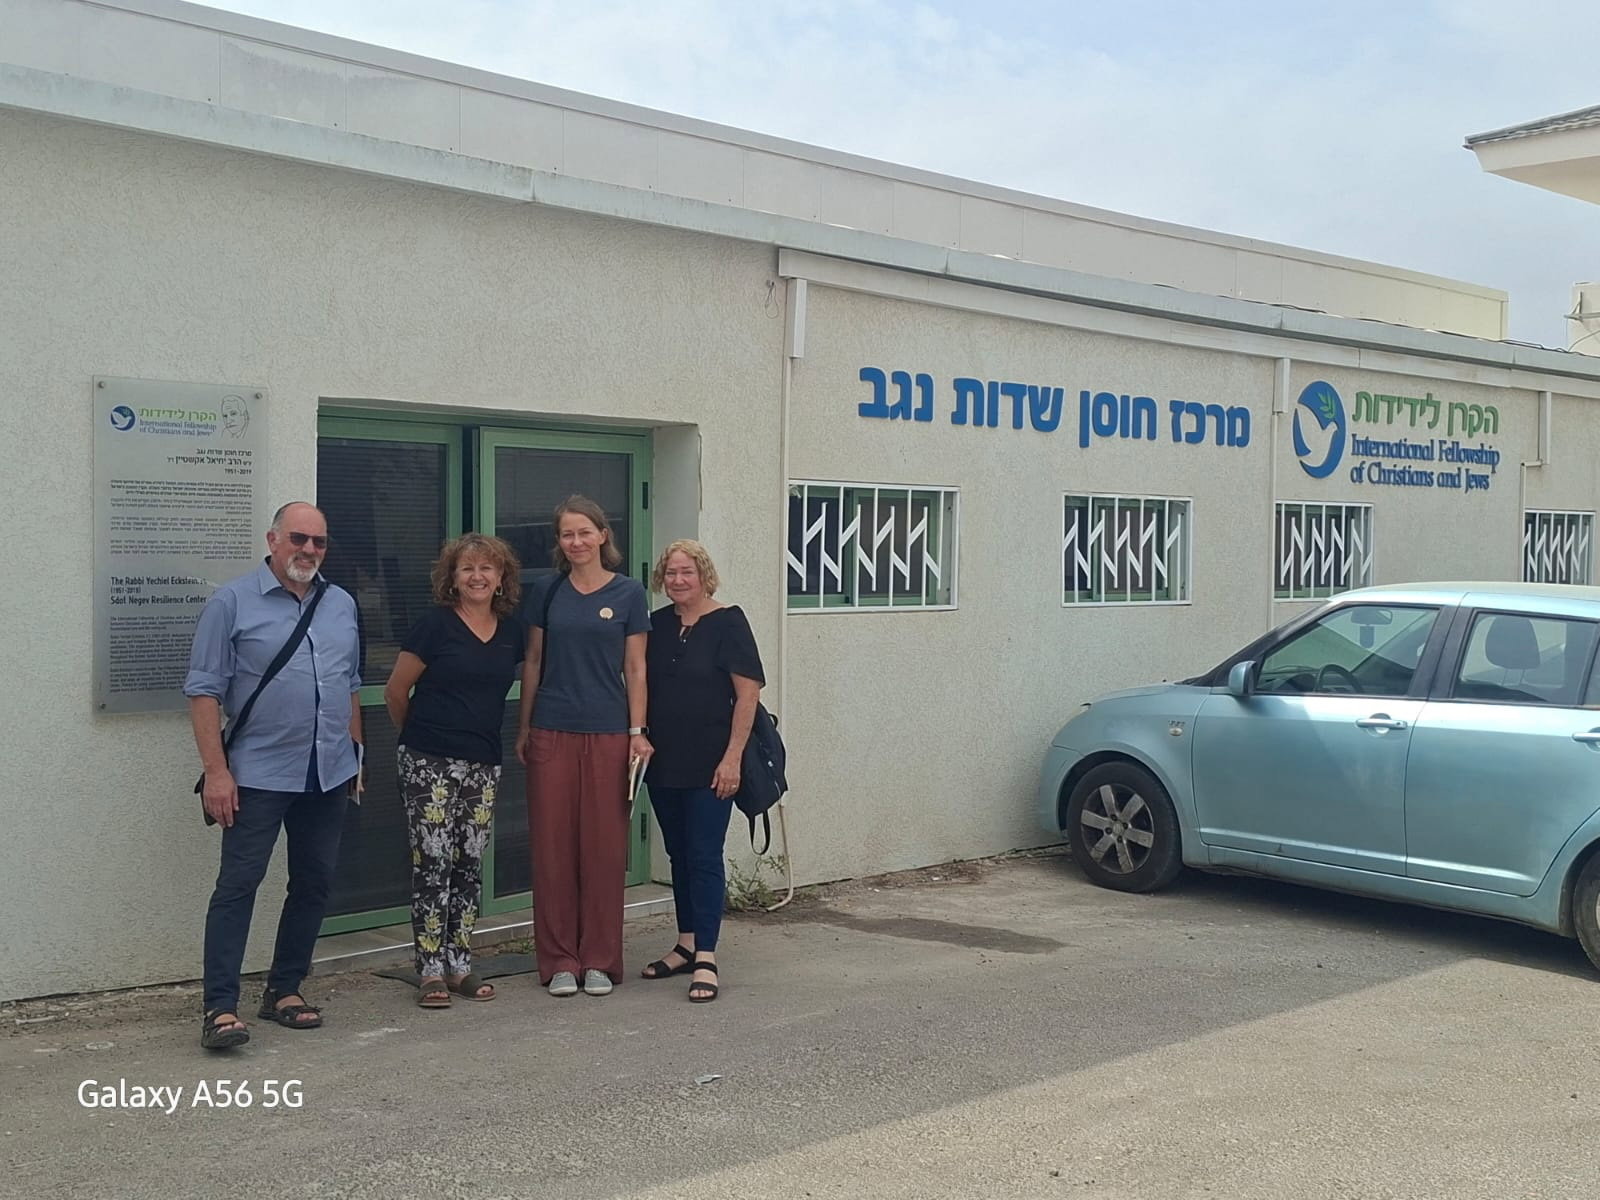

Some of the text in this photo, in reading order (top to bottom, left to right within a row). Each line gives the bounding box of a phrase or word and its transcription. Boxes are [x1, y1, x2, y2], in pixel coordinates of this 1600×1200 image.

[140, 407, 217, 422] הקרן לידידות
[858, 366, 1251, 449] מרכז חוסן שדות נגב
[1352, 391, 1499, 438] הקרן לידידות
[1351, 433, 1500, 474] International Fellowship
[1350, 460, 1489, 494] of Christians and Jews
[111, 576, 124, 585] The
[125, 576, 145, 585] Rabbi
[146, 576, 170, 585] Yechiel
[128, 595, 150, 606] Negev
[151, 595, 184, 604] Resilience
[186, 595, 207, 604] Center
